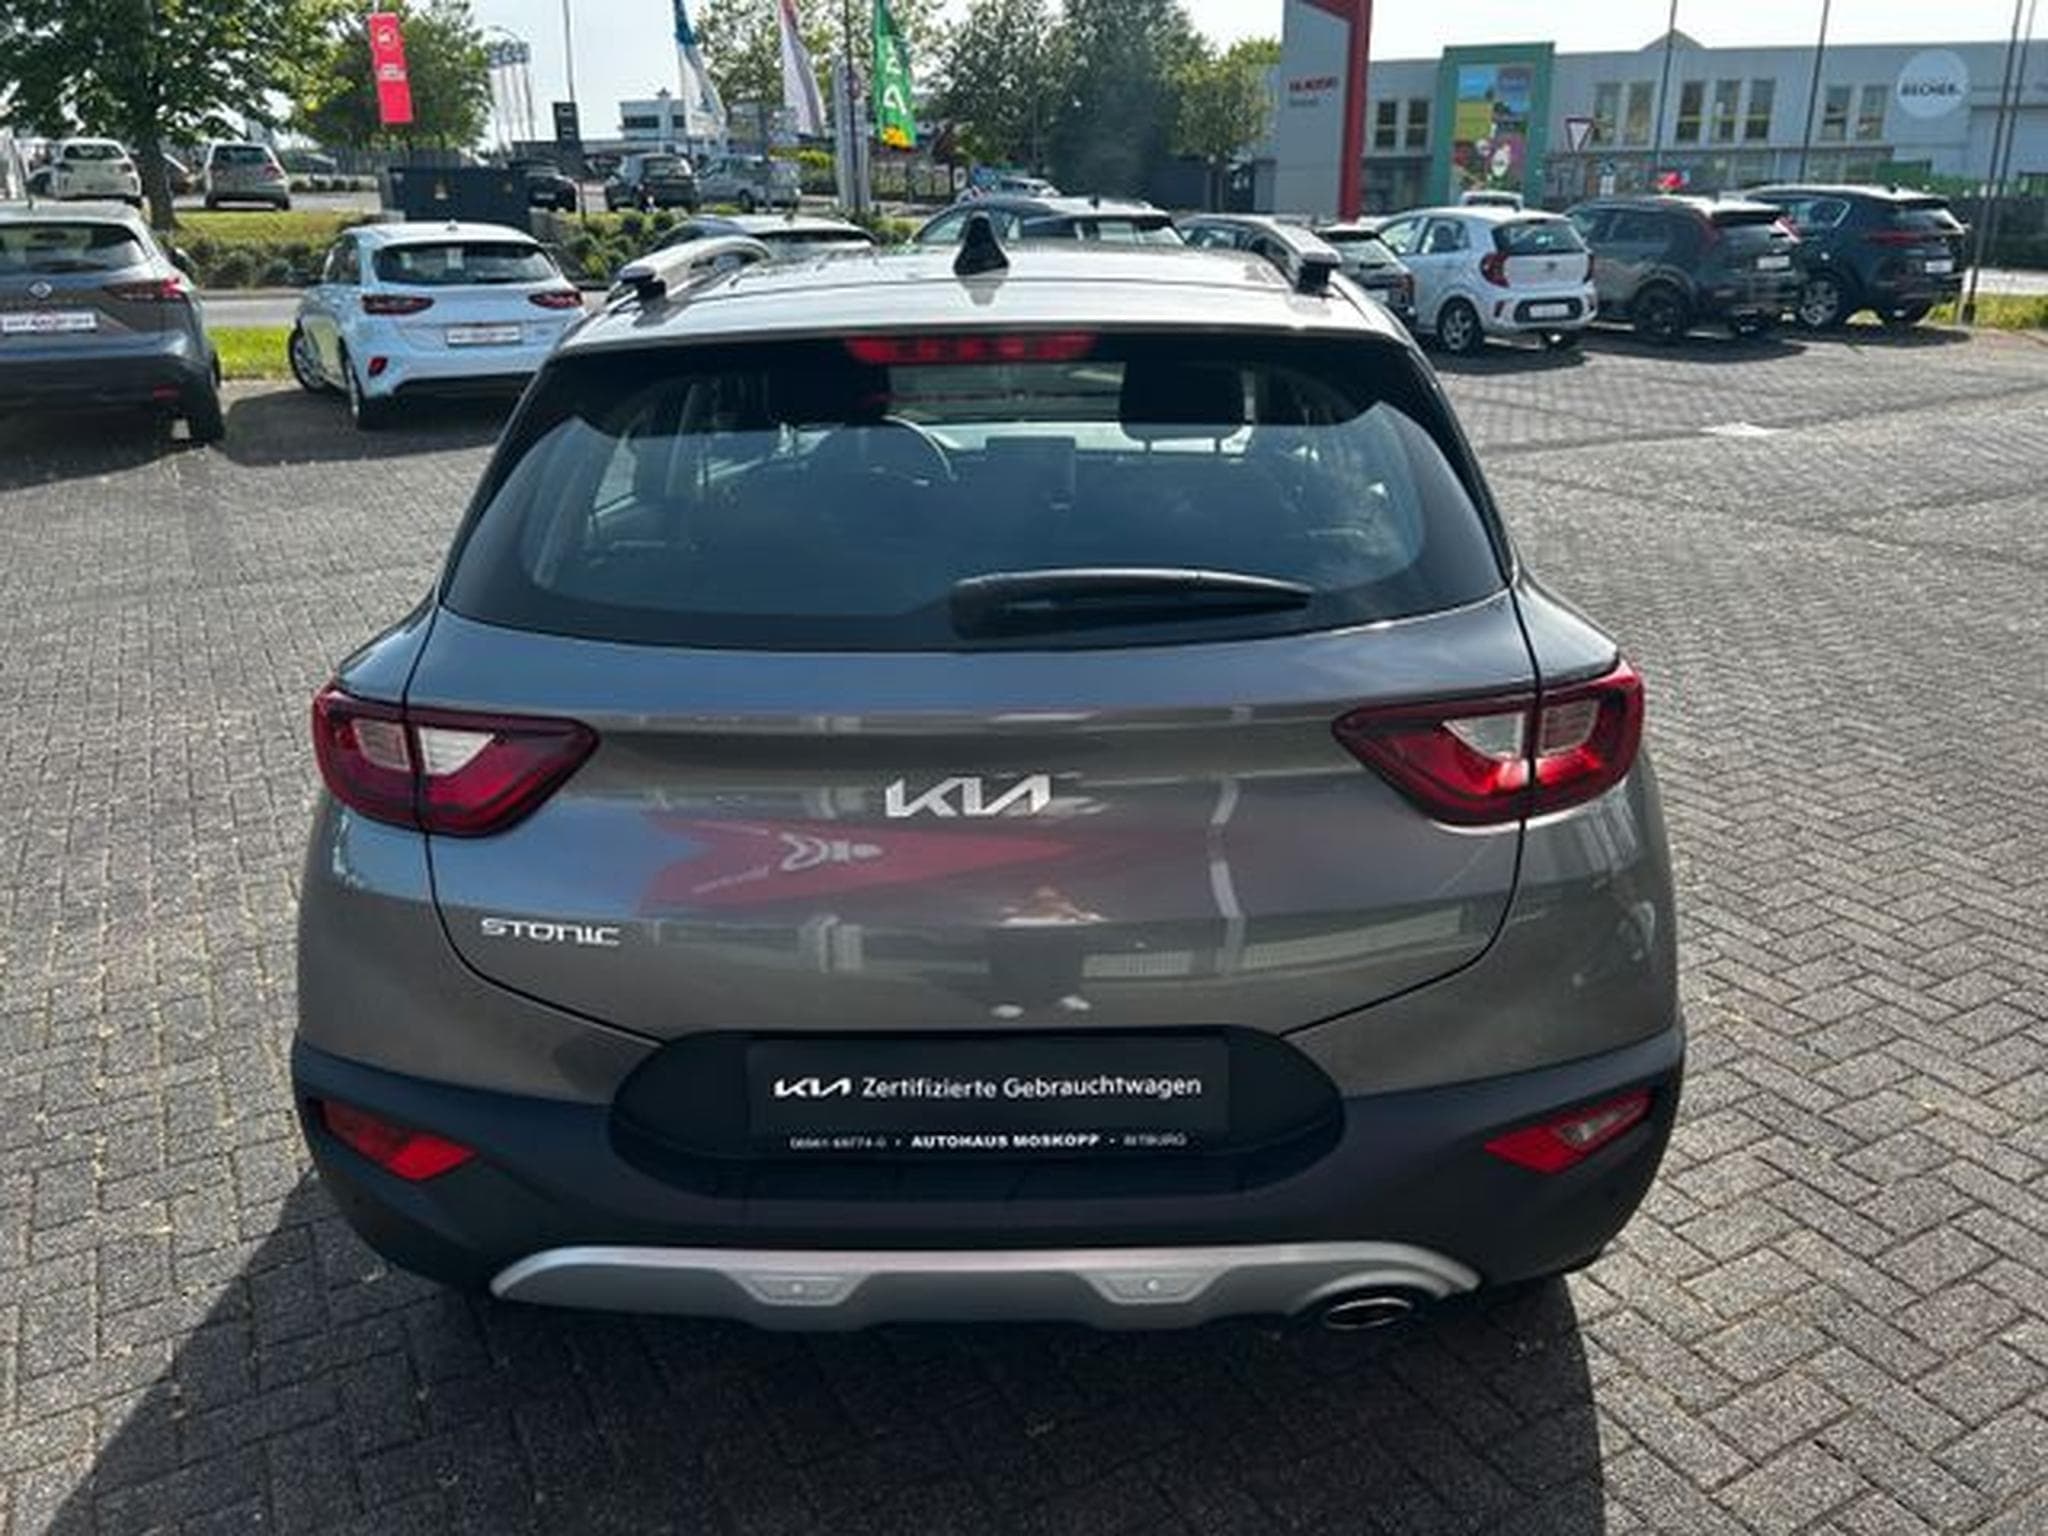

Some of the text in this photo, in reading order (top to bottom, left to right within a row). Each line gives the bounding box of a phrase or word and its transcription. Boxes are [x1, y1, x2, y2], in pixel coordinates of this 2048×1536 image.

[886, 774, 1050, 817] KIA
[481, 917, 620, 946] STONIC
[774, 1075, 1202, 1099] KIA Zertifizierte Gebrauchtwagen
[911, 1134, 1008, 1148] AUTOHAUS
[1013, 1133, 1100, 1148] MOSKOPP
